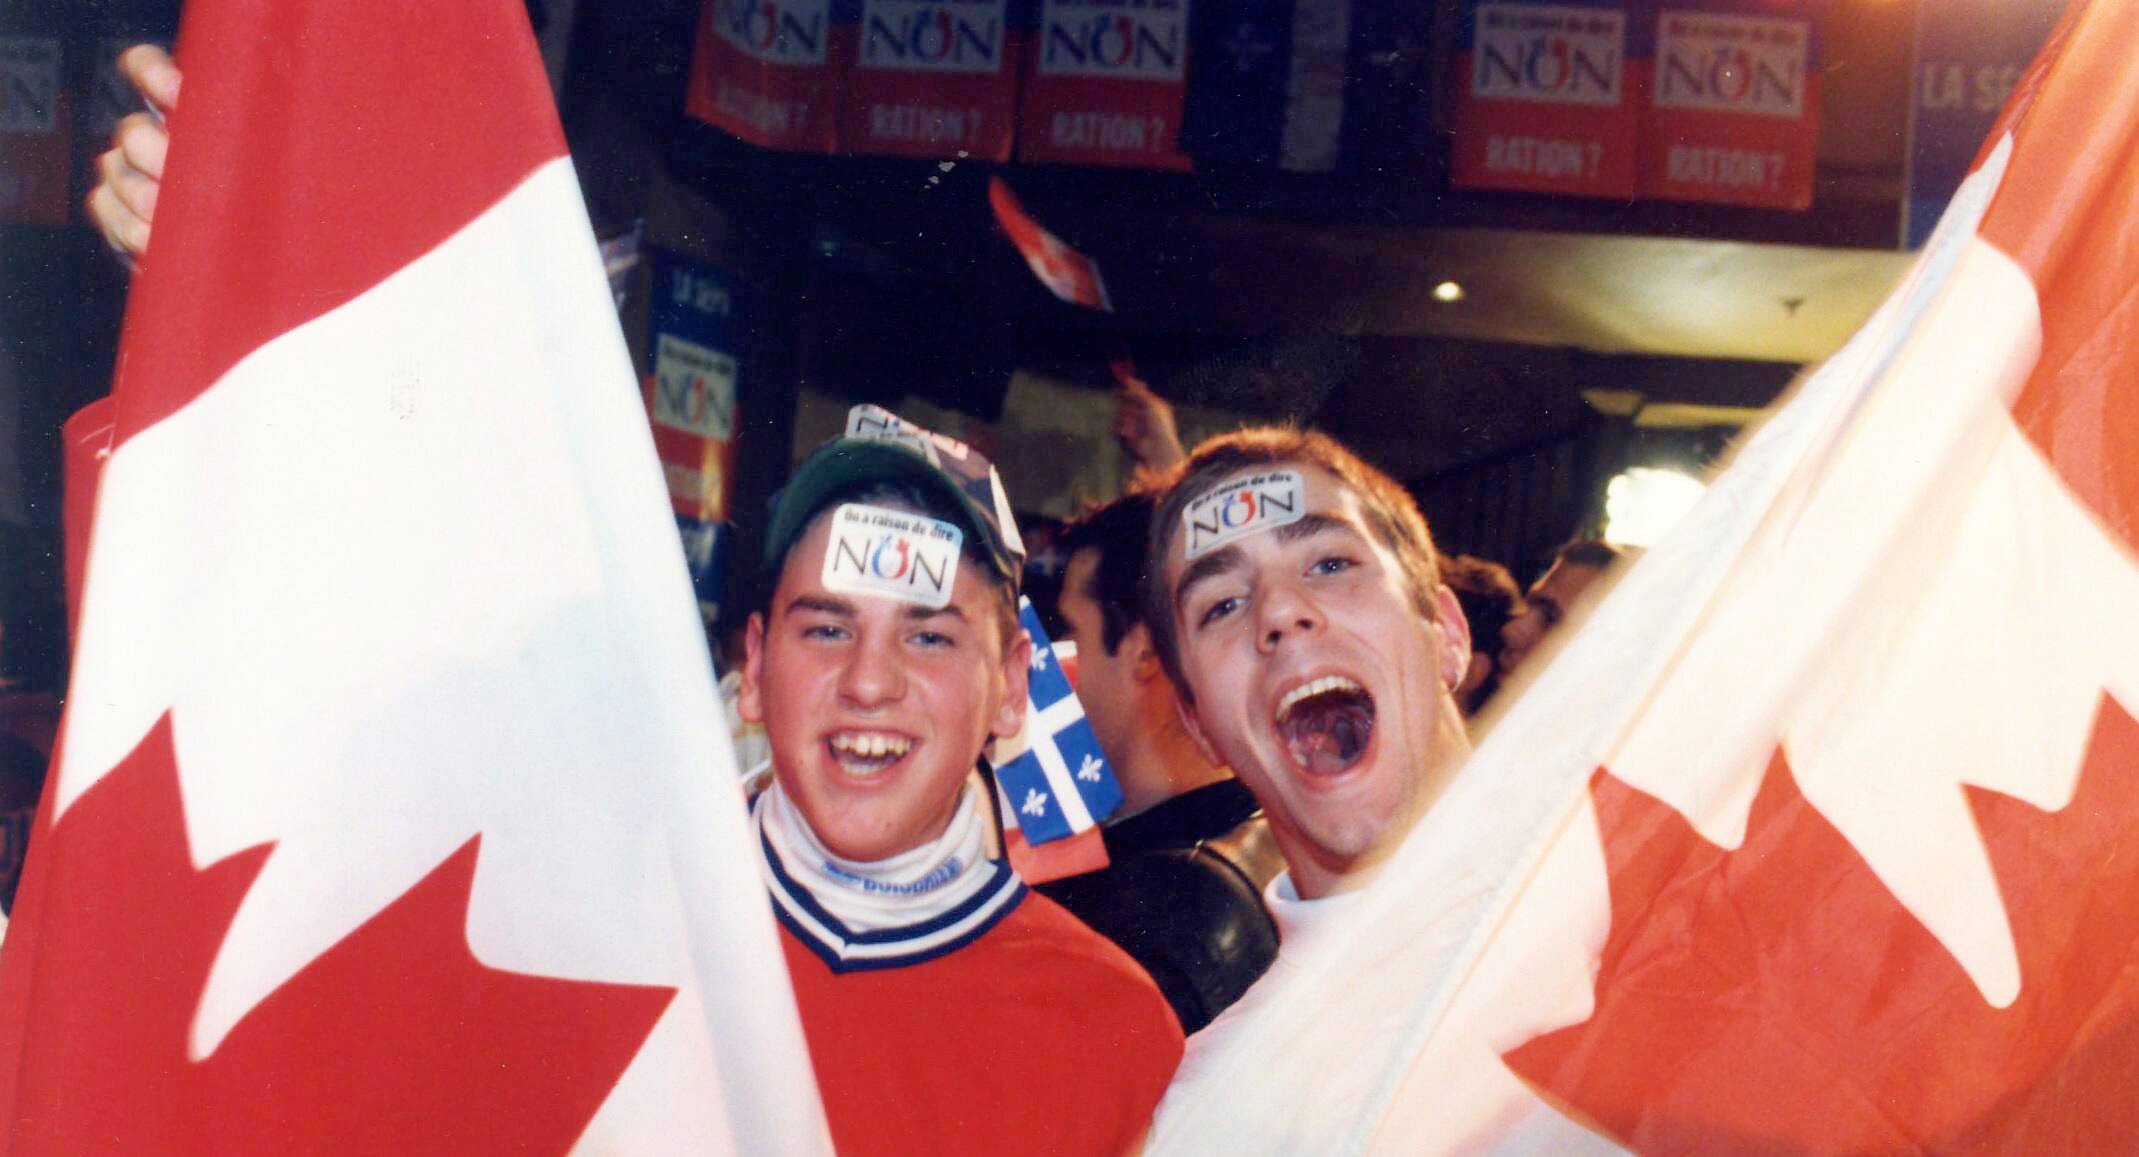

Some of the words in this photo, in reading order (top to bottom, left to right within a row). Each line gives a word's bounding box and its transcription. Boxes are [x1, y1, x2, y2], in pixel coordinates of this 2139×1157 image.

[868, 8, 997, 60] NON
[1048, 12, 1178, 66] NON
[1479, 36, 1615, 93] NON
[1663, 47, 1799, 103] NON
[1921, 61, 1964, 109] LA
[912, 521, 926, 536] de
[930, 523, 954, 542] dire
[1193, 490, 1293, 549] NON
[834, 536, 948, 593] NON
